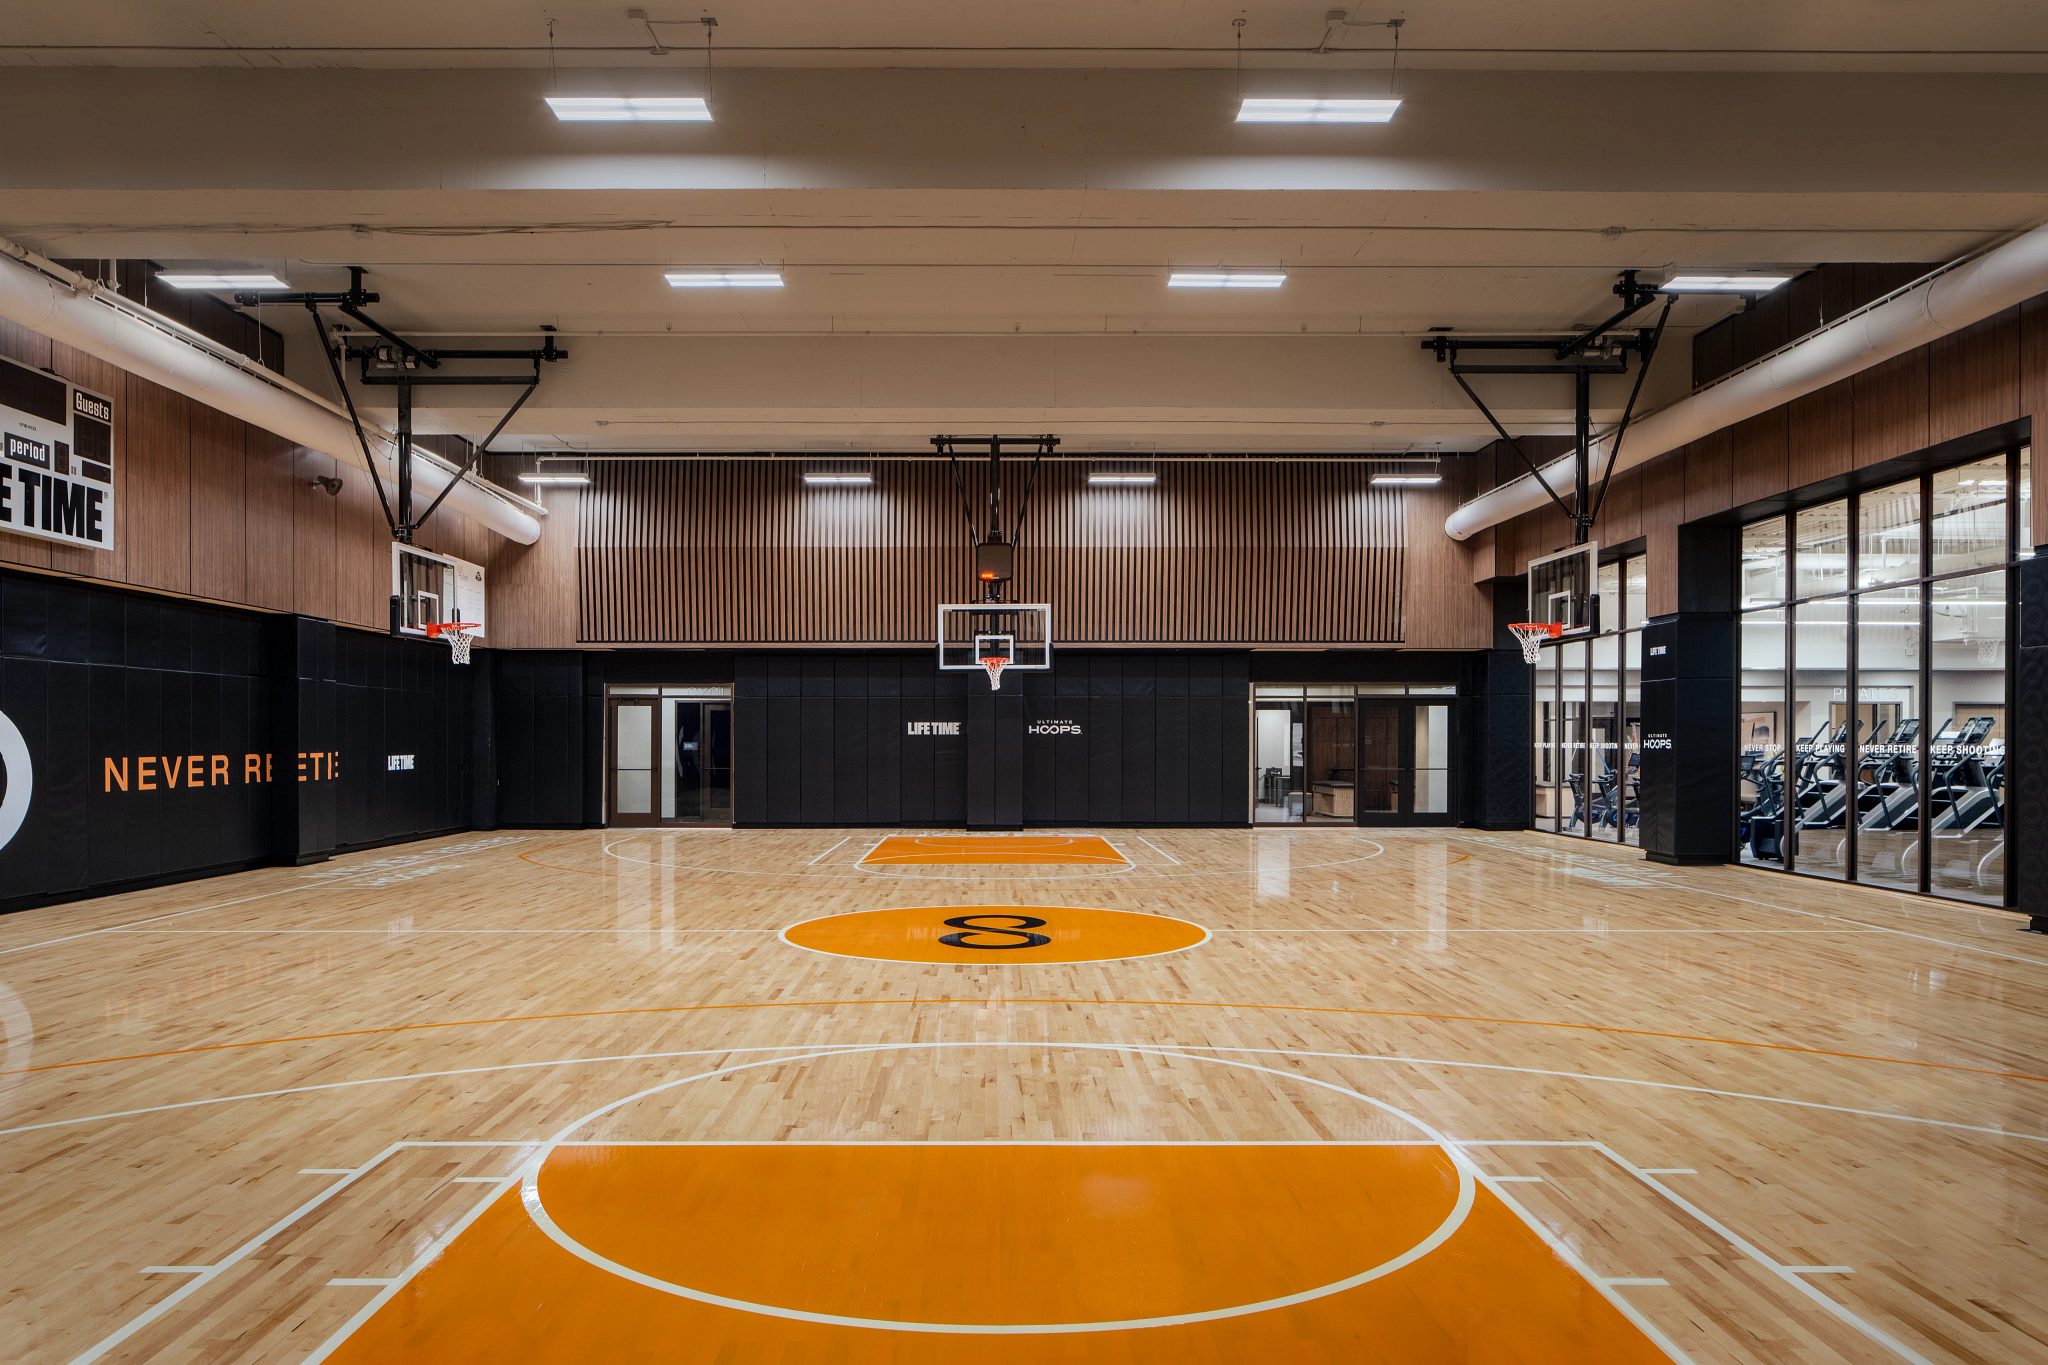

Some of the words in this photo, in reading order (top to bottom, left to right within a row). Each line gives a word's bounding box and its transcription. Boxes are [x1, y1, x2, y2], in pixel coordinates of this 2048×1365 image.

[76, 391, 109, 420] Guests
[10, 438, 45, 461] period
[19, 467, 103, 543] TIME
[1833, 687, 1898, 701] PIATES
[907, 721, 930, 735] LIFE
[930, 721, 960, 735] TIME
[1028, 725, 1082, 735] HOOPS
[1643, 739, 1673, 750] HOOPS
[1744, 744, 1763, 752] NEVER
[1764, 744, 1782, 752] STOP
[1795, 744, 1812, 753] KEEP
[1815, 744, 1845, 753] PLAYING
[1859, 745, 1884, 754] NEVER
[1887, 745, 1917, 754] RETIRE
[1930, 745, 1954, 755] KEEP
[1957, 745, 2005, 756] SHOOTING
[104, 755, 229, 793] NEVER
